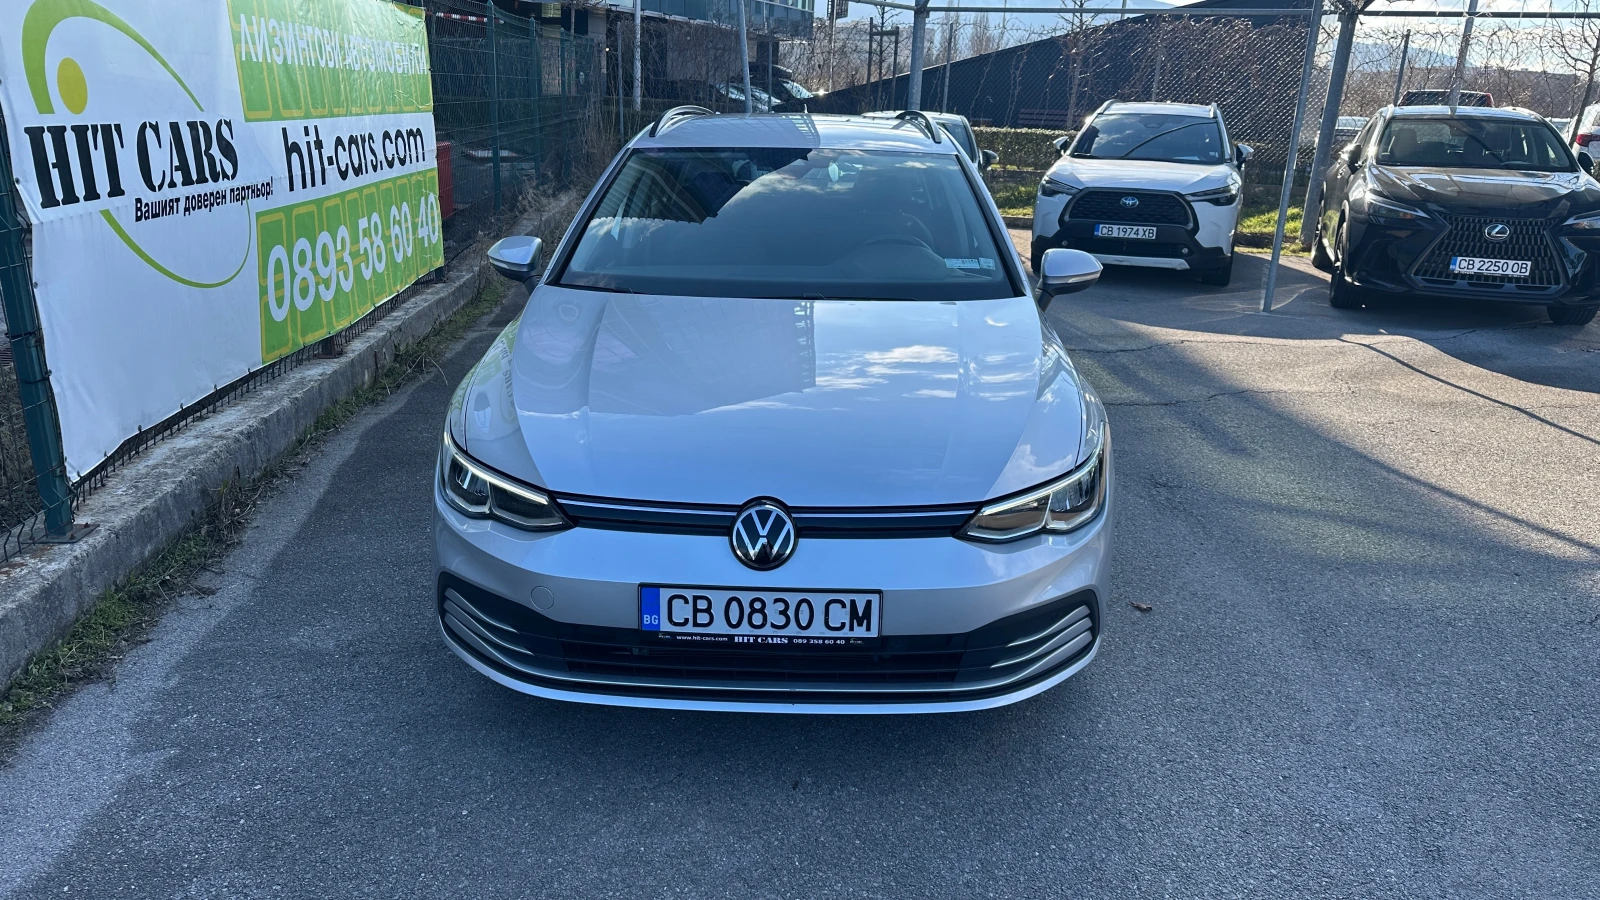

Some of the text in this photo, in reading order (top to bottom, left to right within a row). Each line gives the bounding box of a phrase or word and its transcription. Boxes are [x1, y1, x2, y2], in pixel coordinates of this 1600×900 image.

[240, 14, 342, 69] ЛИЗИНГОВИ
[24, 118, 238, 209] HIT CARS
[281, 125, 425, 192] hit-cars.com
[135, 176, 274, 222] Вашият доверен партньор!
[1100, 225, 1114, 236] CB
[1116, 226, 1140, 237] 1974
[1141, 227, 1155, 238] XB
[267, 192, 438, 322] 0893 58 60 40
[1458, 258, 1475, 270] CB
[1477, 259, 1509, 273] 2250
[643, 614, 659, 625] BG
[667, 593, 873, 632] CB 0830 CM
[676, 634, 728, 642] www.hit-cars.com
[734, 635, 756, 643] HIT
[757, 636, 789, 644] CARS
